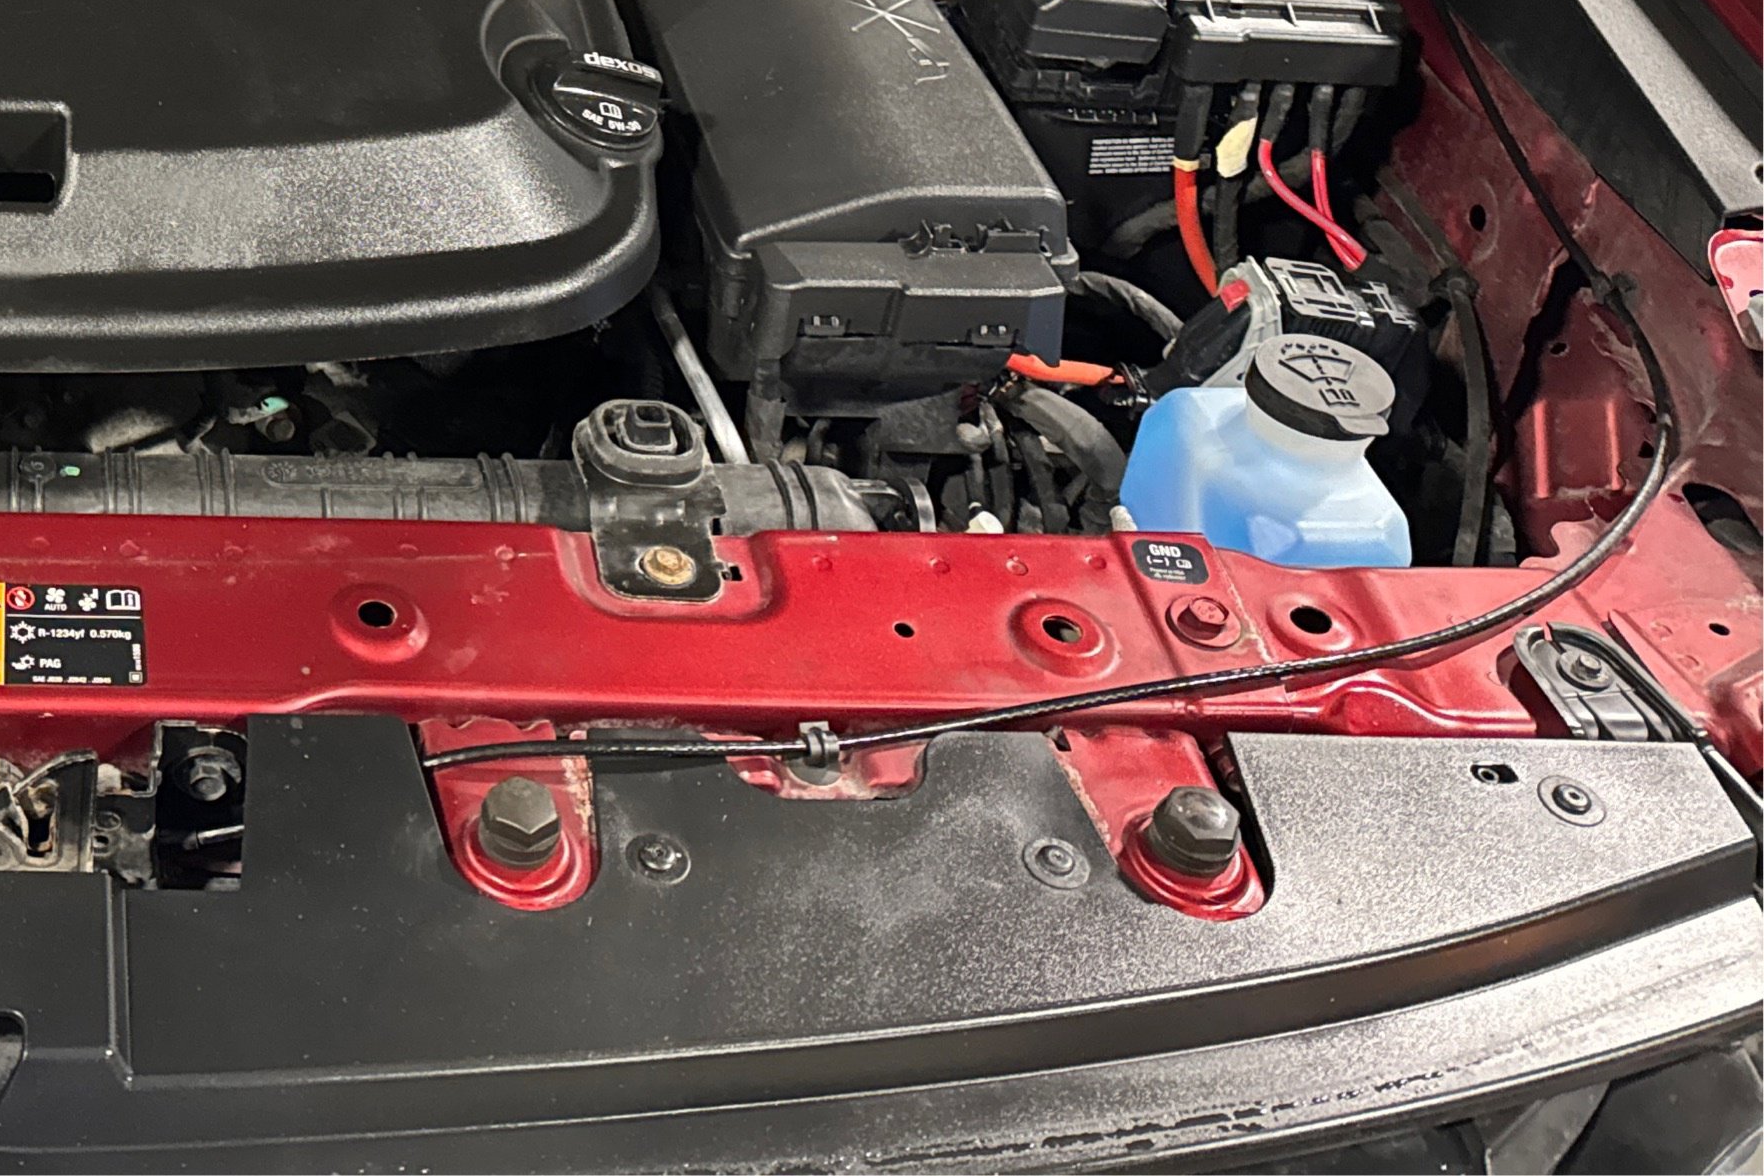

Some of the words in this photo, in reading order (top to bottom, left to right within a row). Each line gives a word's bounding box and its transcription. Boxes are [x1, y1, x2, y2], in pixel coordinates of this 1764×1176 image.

[583, 51, 657, 79] dexos
[582, 109, 604, 126] SAE
[1148, 543, 1181, 557] GND
[44, 604, 68, 612] AUTO
[37, 628, 85, 640] R-1234yf
[90, 629, 132, 641] 0.570kg
[39, 658, 62, 669] PAG
